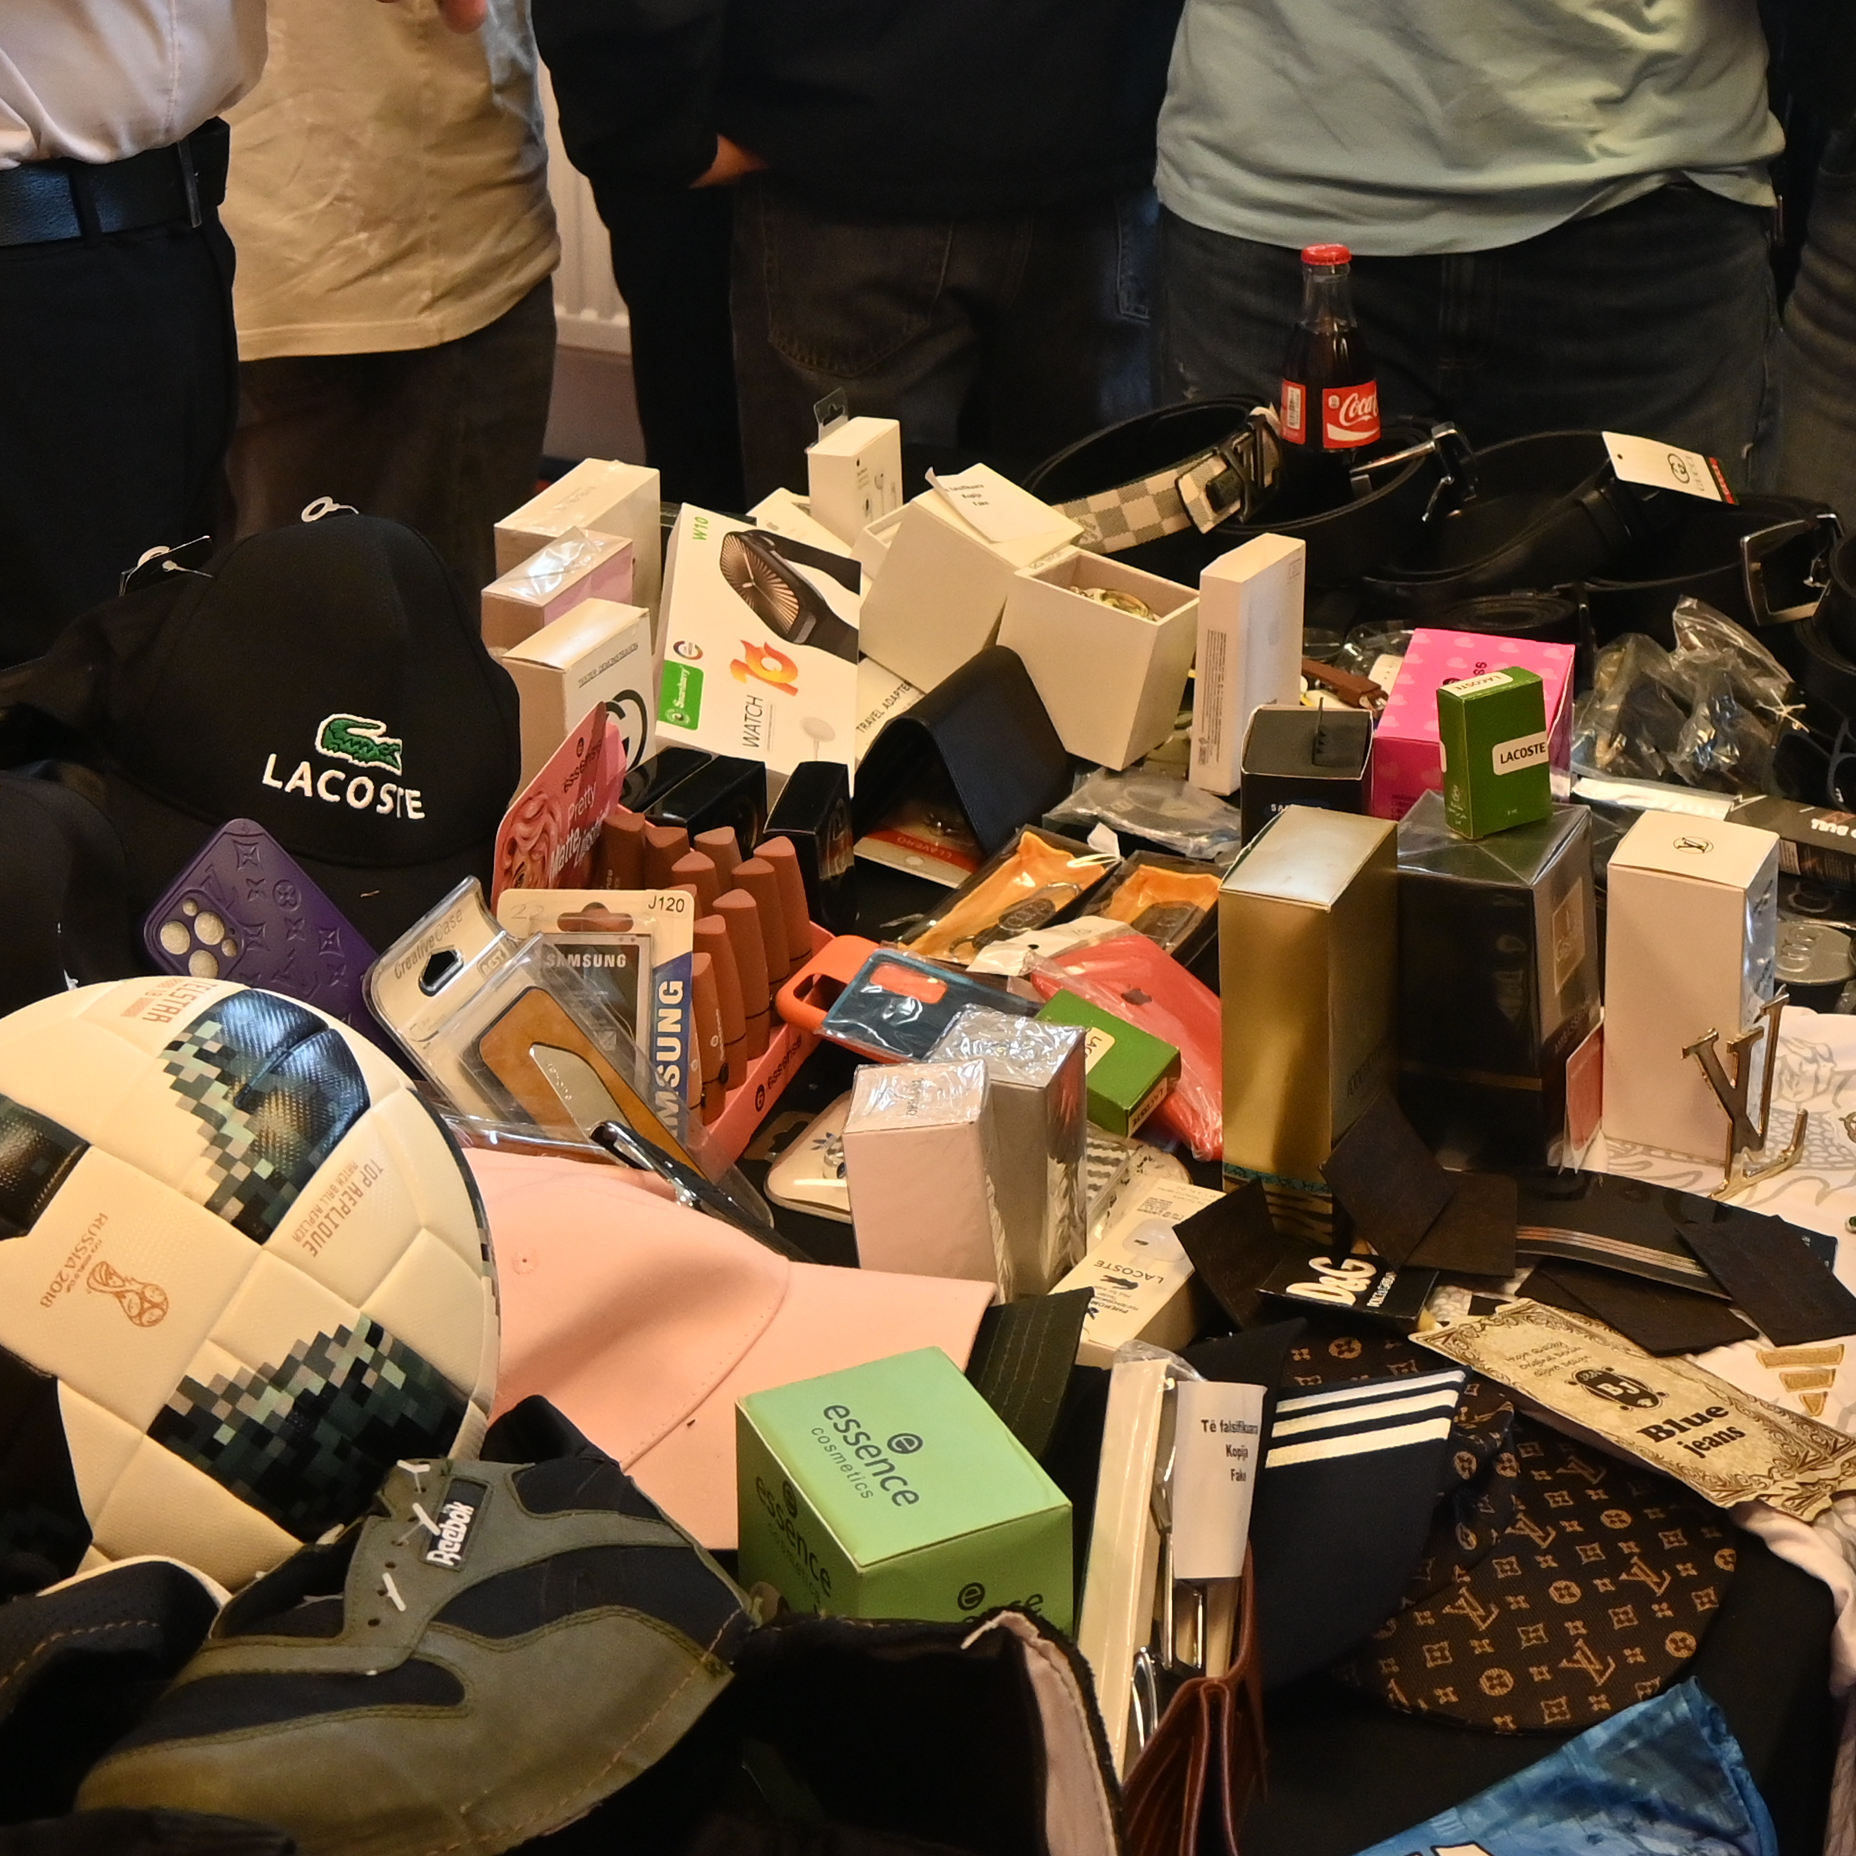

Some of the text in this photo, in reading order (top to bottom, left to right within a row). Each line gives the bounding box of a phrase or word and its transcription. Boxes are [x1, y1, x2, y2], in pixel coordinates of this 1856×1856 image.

[692, 516, 710, 542] W10
[742, 694, 764, 748] WATCH
[855, 710, 886, 734] TRAVEL
[1499, 741, 1546, 765] LACOSTE
[260, 752, 426, 821] LACOSTE
[566, 780, 598, 828] Pretty
[648, 896, 685, 913] J120
[545, 953, 627, 969] SAMSUNG
[360, 1158, 384, 1188] TOP
[39, 1212, 109, 1309] RUSSIA 2018
[1093, 1258, 1165, 1285] LACOSTE
[1595, 1380, 1641, 1397] BJ
[1635, 1404, 1730, 1444] Blue
[1676, 1423, 1747, 1460] jeans
[811, 1425, 874, 1502] cosmetics
[821, 1402, 921, 1509] essence
[426, 1501, 475, 1566] Reebok
[755, 1475, 832, 1600] essence
